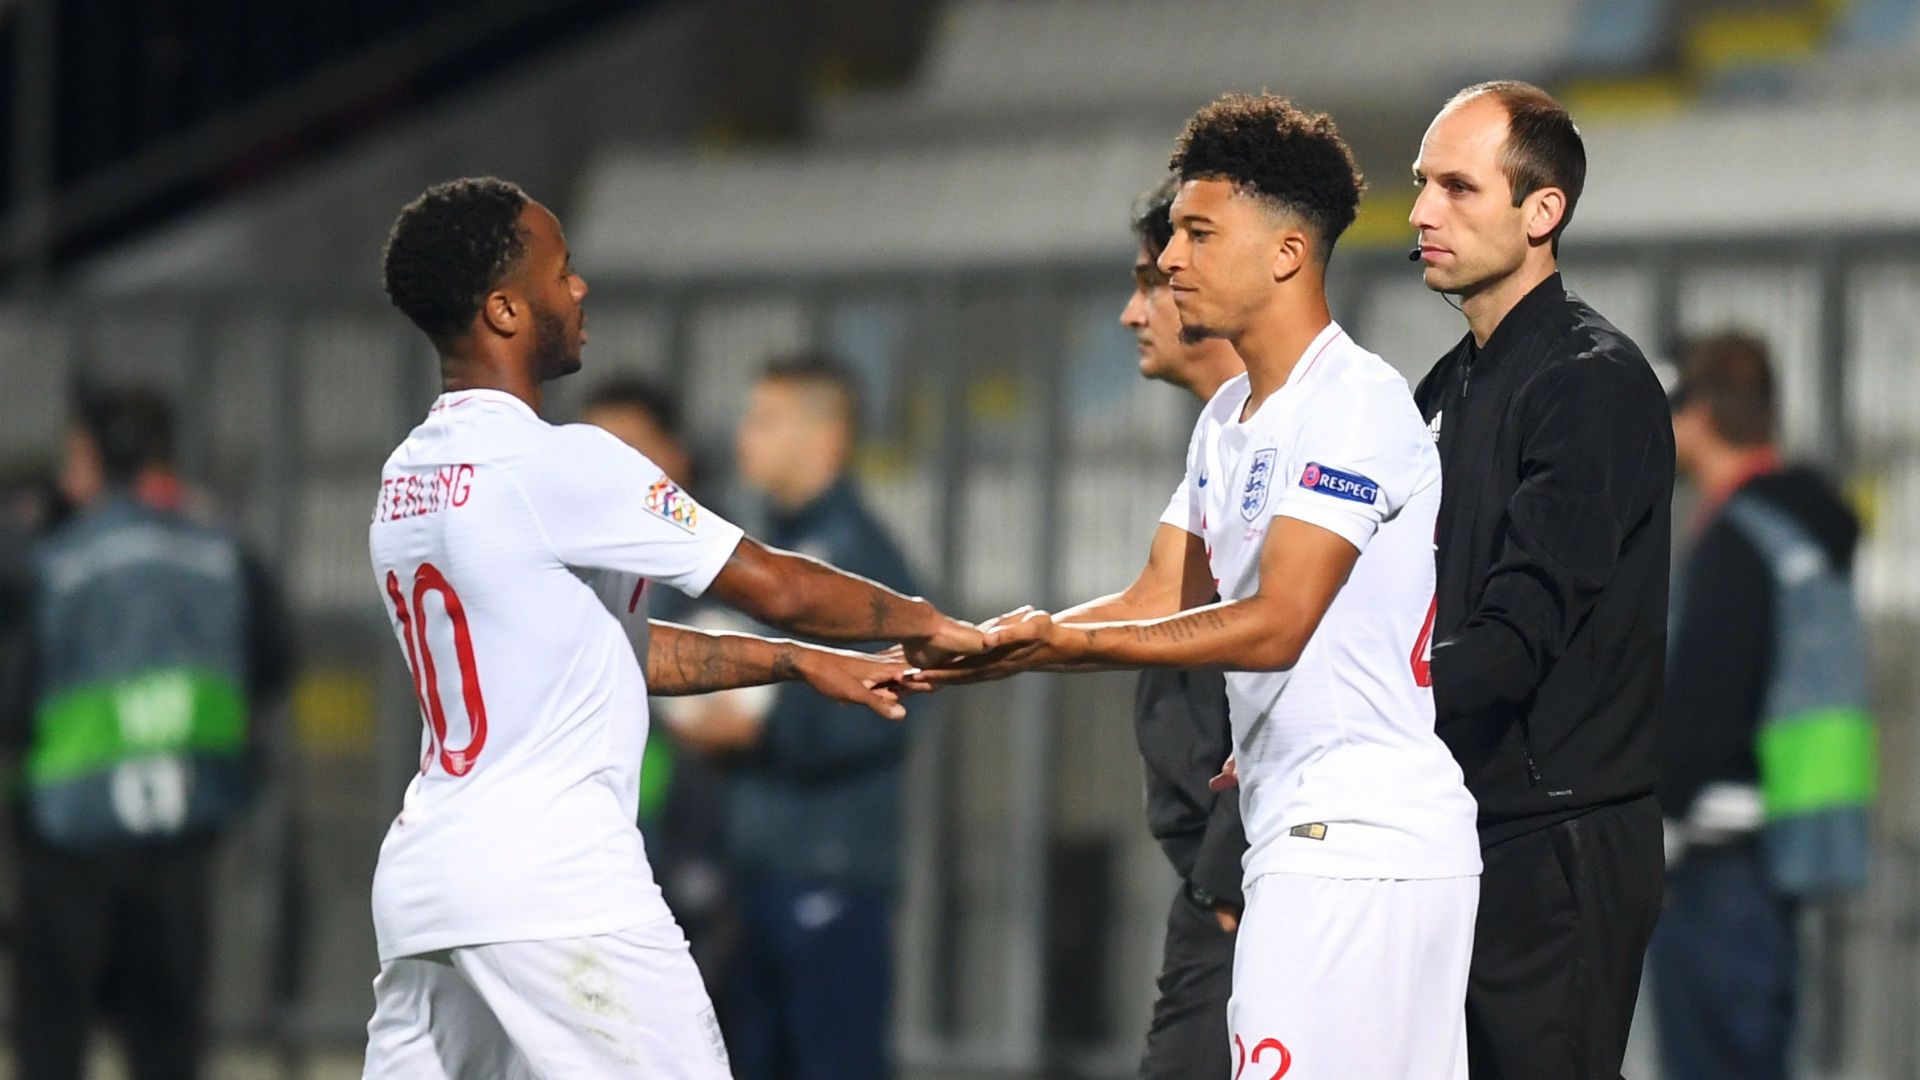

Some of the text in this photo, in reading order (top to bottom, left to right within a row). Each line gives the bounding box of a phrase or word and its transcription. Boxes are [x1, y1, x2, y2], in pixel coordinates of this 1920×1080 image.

[376, 464, 474, 522] TERLING
[1319, 473, 1377, 501] RESPECT
[386, 563, 487, 777] 10
